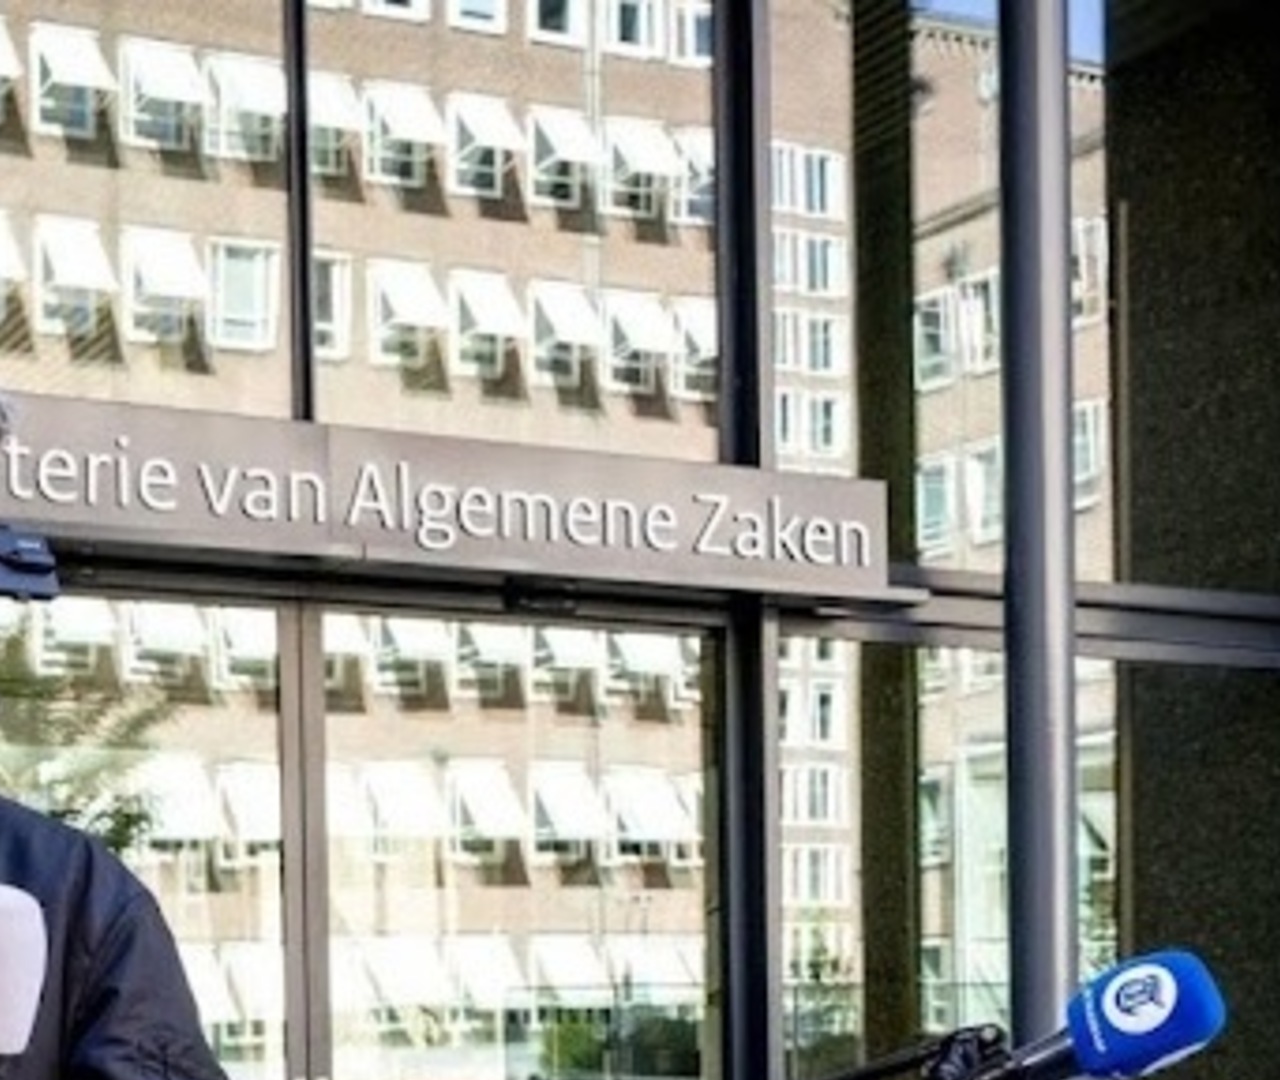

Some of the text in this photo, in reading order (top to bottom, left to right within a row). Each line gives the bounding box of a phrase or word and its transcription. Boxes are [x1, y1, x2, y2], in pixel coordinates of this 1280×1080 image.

[197, 462, 326, 523] van
[345, 460, 677, 549] Algemene
[692, 493, 870, 568] Zaken
